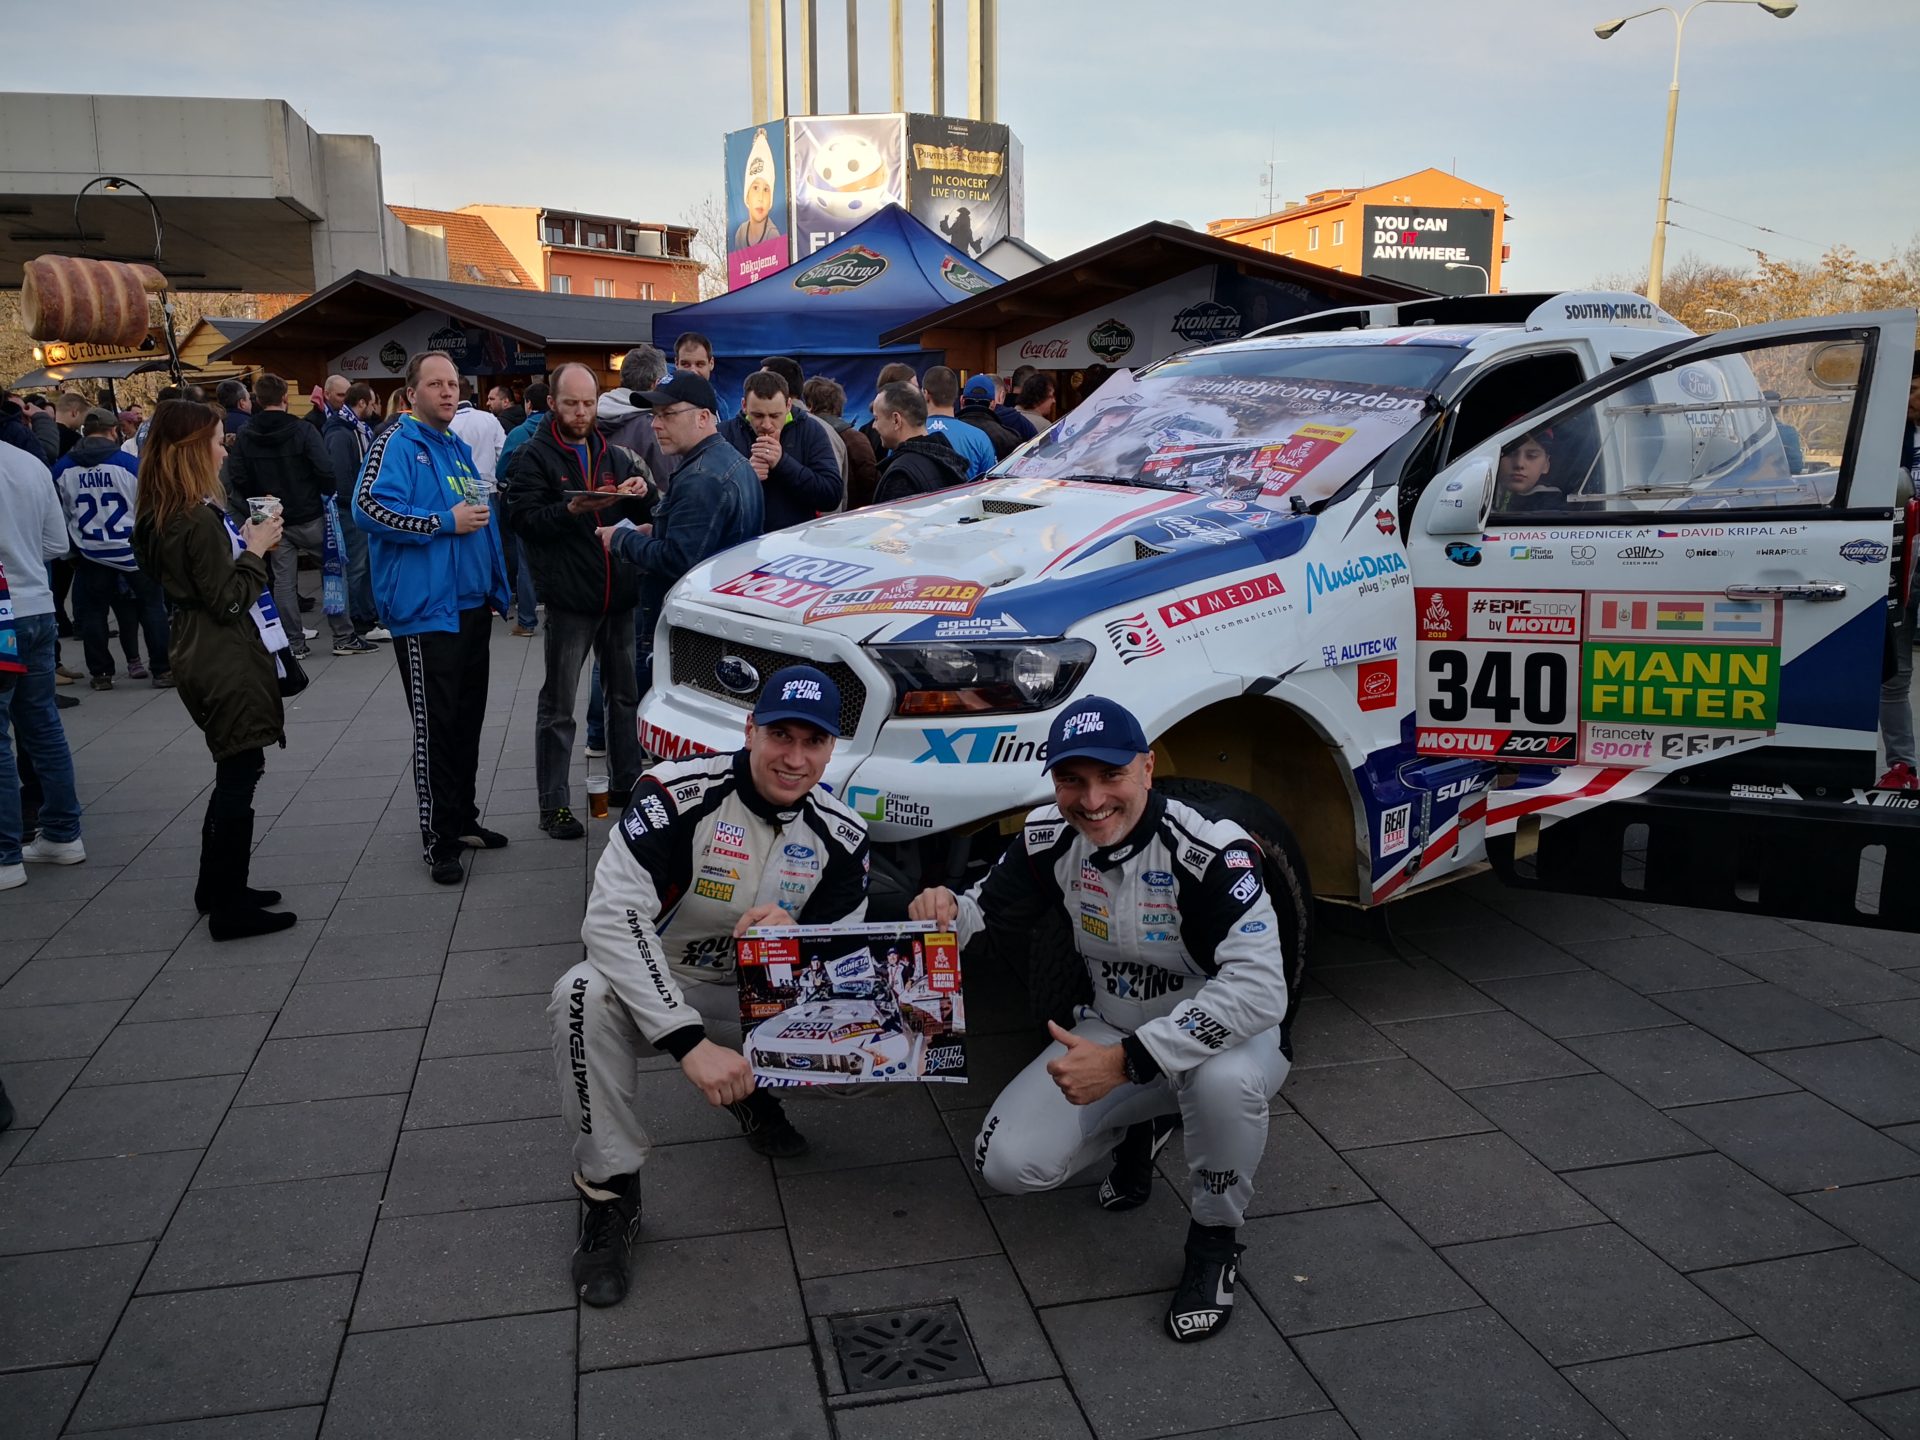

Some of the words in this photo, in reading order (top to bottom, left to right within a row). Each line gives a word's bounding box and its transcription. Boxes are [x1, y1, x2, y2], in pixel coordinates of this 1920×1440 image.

[932, 174, 943, 185] IN
[946, 176, 988, 189] CONCERT
[931, 187, 949, 197] LIVE
[953, 189, 965, 199] TO
[969, 190, 990, 201] FILM
[1375, 216, 1409, 230] YOU
[1413, 217, 1448, 232] CAN
[1374, 231, 1398, 244] DO
[1402, 231, 1419, 245] IT
[1373, 245, 1470, 261] ANYWHERE.
[740, 255, 779, 275] Děkujeme,
[802, 258, 880, 283] Starobrno
[1174, 314, 1241, 330] KOMETA
[429, 337, 467, 348] KOMETA
[1091, 330, 1132, 351] Starobrno
[1193, 378, 1426, 413] #nikdytonevzdam
[79, 468, 114, 488] KÁŇA
[75, 492, 134, 541] 22
[1502, 531, 1547, 541] TOMAS
[1550, 530, 1633, 540] OUREDNICEK
[1681, 527, 1724, 537] DAVID
[1728, 526, 1777, 537] KRIPAL
[1625, 546, 1659, 559] PRIM
[1841, 547, 1888, 555] KOMETA
[763, 556, 870, 586] LIQUI
[720, 574, 823, 608] MOLY
[1358, 581, 1379, 597] plug
[1391, 572, 1411, 588] play
[826, 590, 876, 605] 340
[918, 585, 977, 600] 2018
[809, 604, 843, 619] PERU
[891, 600, 968, 613] ARGENTINA
[937, 616, 1003, 630] agados
[1175, 626, 1210, 645] visual
[1214, 603, 1295, 632] communication
[1423, 617, 1453, 632] DAKAR
[1489, 618, 1502, 632] by
[1509, 618, 1573, 633] MOTUL
[1341, 638, 1382, 661] ALUTEC
[1383, 636, 1398, 652] KK
[1592, 650, 1769, 685] MANN
[783, 680, 821, 693] SOUTH
[1428, 649, 1568, 726] 340
[1591, 684, 1767, 720] FILTER
[1063, 711, 1101, 729] SOUTH
[911, 724, 1050, 765] XTline
[1417, 731, 1496, 752] MOTUL
[1503, 734, 1574, 753] 300V
[1591, 741, 1653, 760] sport
[676, 785, 701, 801] OMP
[886, 791, 910, 801] Zoner
[1436, 774, 1480, 803] SUV
[1731, 783, 1783, 794] agados
[1842, 788, 1919, 809] XTline
[647, 793, 671, 826] SOUTH
[885, 799, 930, 816] Photo
[885, 810, 933, 828] Studio
[1384, 807, 1408, 835] BEAT
[717, 821, 745, 837] LIQUI
[837, 825, 860, 843] OMP
[1029, 831, 1055, 842] OMP
[715, 831, 743, 847] MOLY
[786, 844, 810, 858] Ford
[1184, 849, 1207, 866] OMP
[703, 864, 731, 875] agados
[1229, 858, 1251, 866] MOLY
[699, 879, 734, 893] MANN
[1149, 872, 1170, 884] Ford
[696, 886, 732, 901] FILTER
[1233, 873, 1257, 901] OMP
[1082, 913, 1108, 928] MANN
[1244, 922, 1264, 932] Ford
[1082, 922, 1107, 940] FILTER
[836, 955, 870, 974] KOMETA
[932, 973, 954, 981] SOUTH
[790, 1022, 831, 1030] LIQUI
[1184, 1006, 1232, 1040] SOUTH
[781, 1030, 826, 1039] MOLY
[924, 1045, 962, 1060] SOUTH
[1178, 1313, 1219, 1330] OMP
